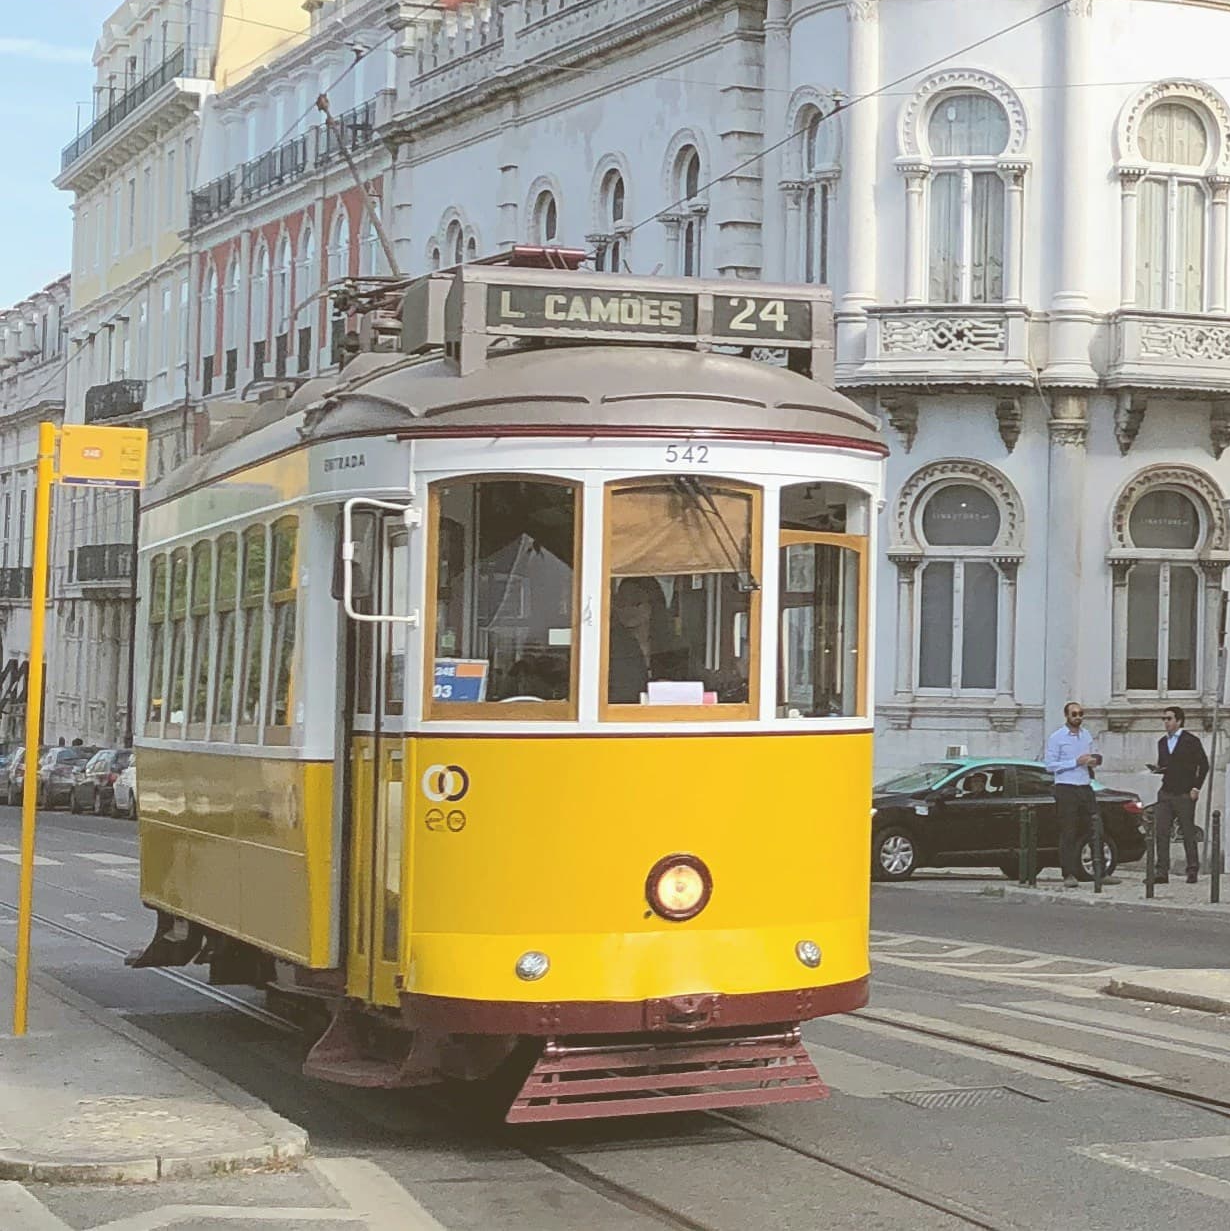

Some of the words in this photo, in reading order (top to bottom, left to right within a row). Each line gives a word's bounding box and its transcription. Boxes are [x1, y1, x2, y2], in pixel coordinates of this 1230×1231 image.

[500, 290, 526, 319] L
[544, 292, 682, 328] CAMÕES
[728, 297, 789, 332] 24
[664, 444, 709, 464] 542
